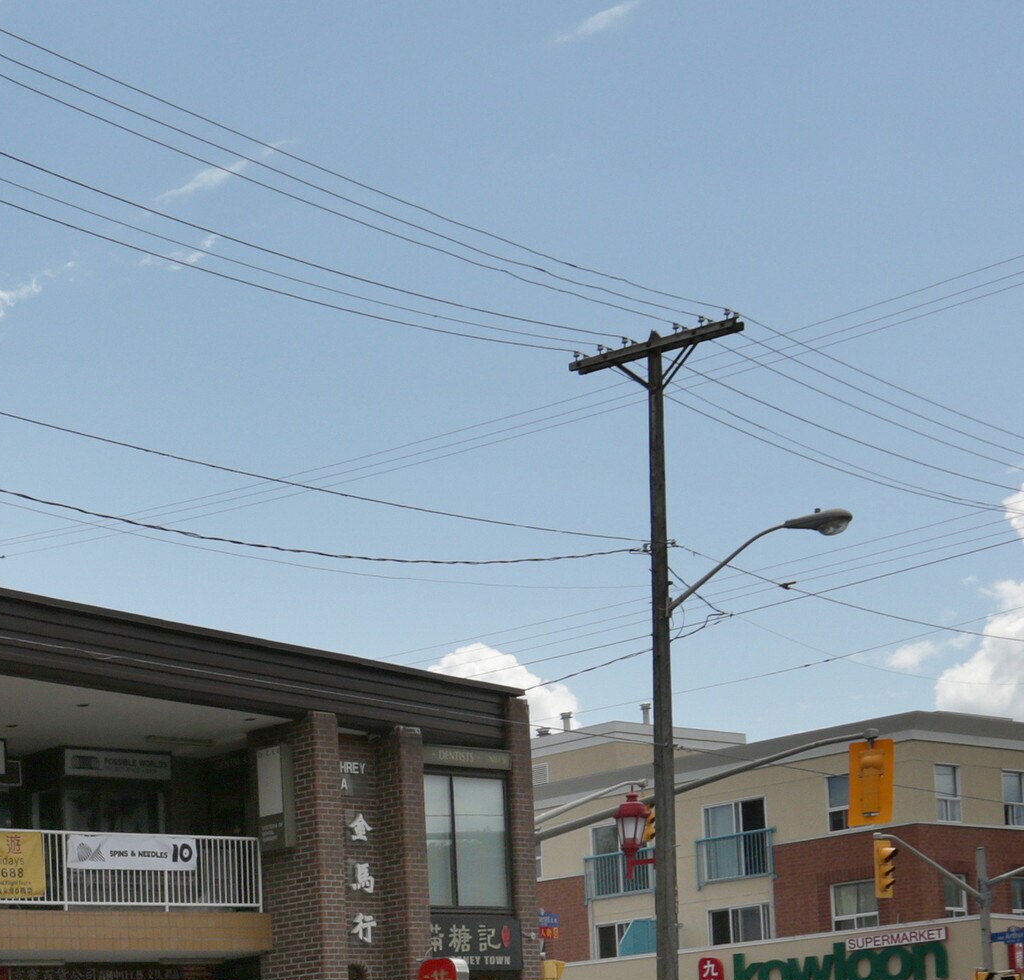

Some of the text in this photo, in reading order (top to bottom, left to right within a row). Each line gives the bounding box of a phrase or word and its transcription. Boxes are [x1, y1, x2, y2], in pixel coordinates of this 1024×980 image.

[438, 749, 474, 763] DENTISTS
[109, 850, 128, 858] SPINS
[138, 850, 168, 859] NEEDLES
[172, 843, 193, 862] 10
[348, 812, 377, 943] 金馬行
[848, 926, 945, 950] SUPERMARKET
[484, 955, 511, 965] TOWN
